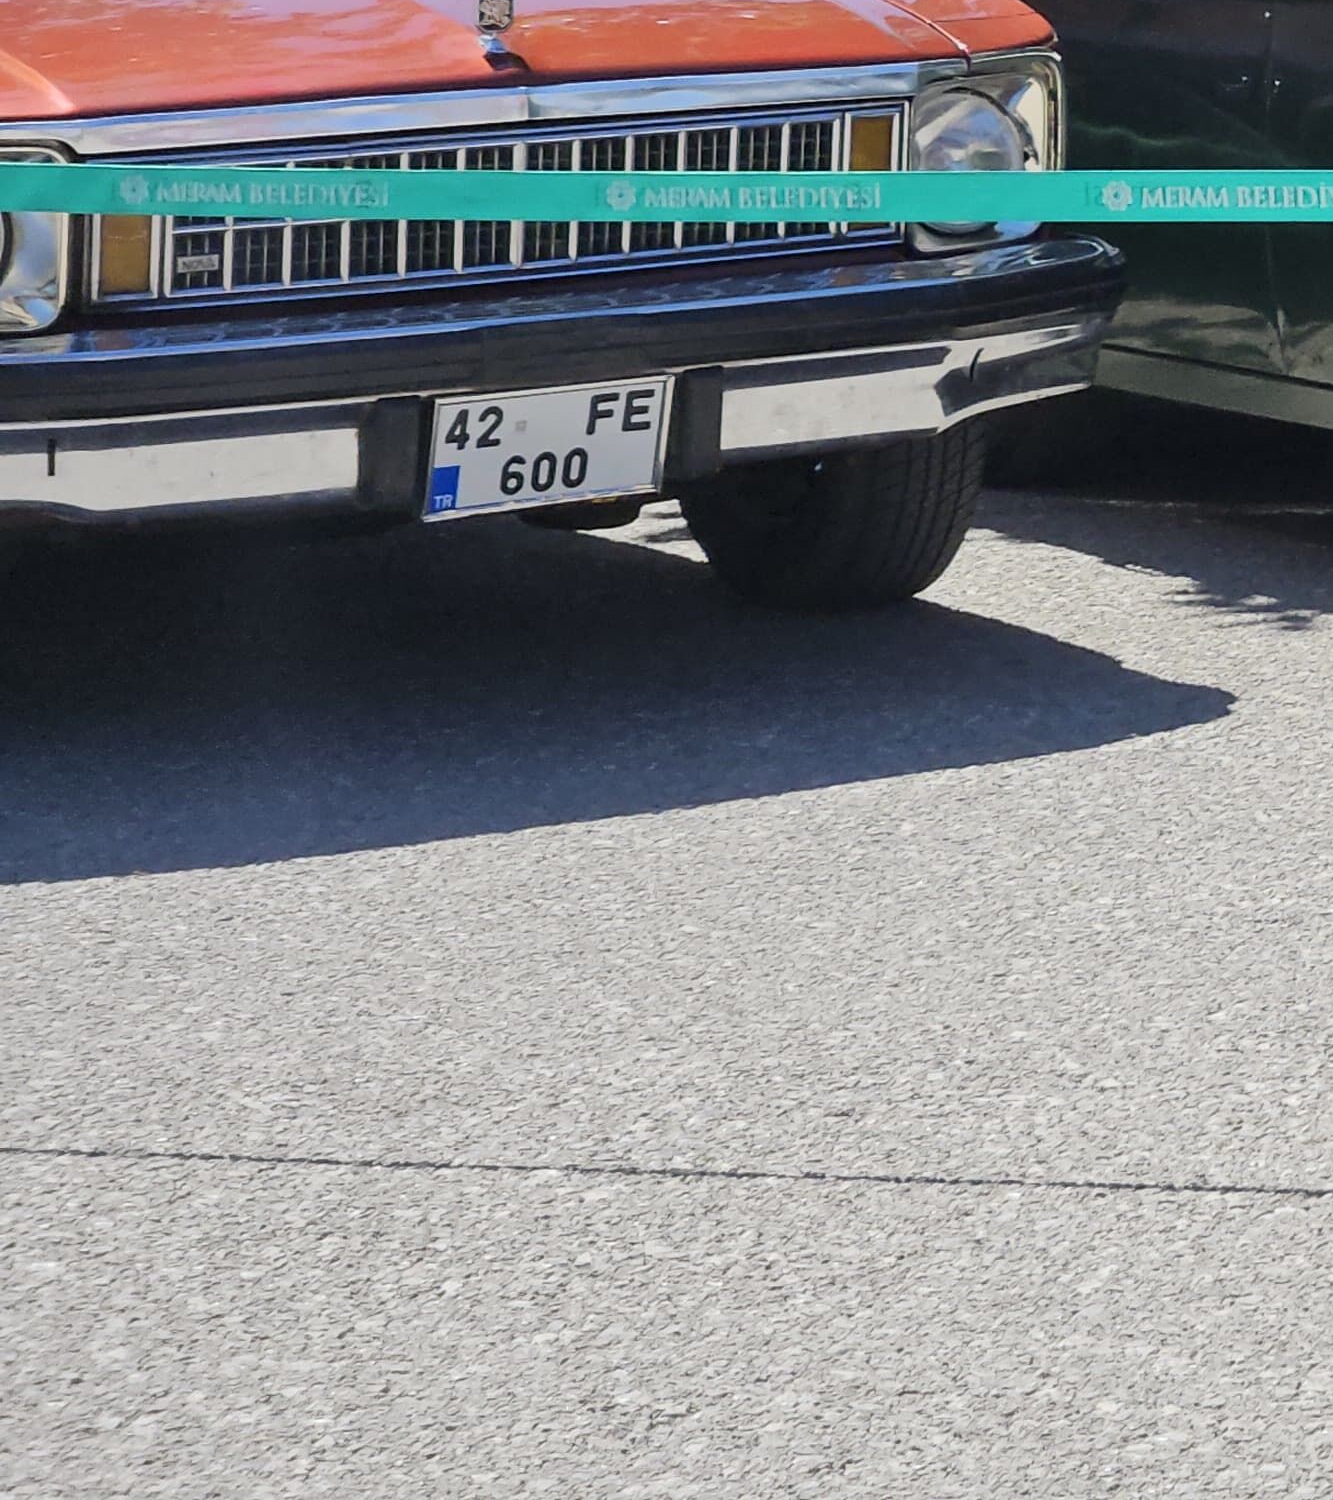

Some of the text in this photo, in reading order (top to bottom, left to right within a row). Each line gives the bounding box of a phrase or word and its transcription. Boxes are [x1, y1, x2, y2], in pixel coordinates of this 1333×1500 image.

[644, 187, 731, 208] MERAM
[1141, 186, 1227, 208] MERAM
[444, 389, 656, 450] 42 FE
[500, 447, 589, 495] 600
[434, 494, 453, 509] TR
